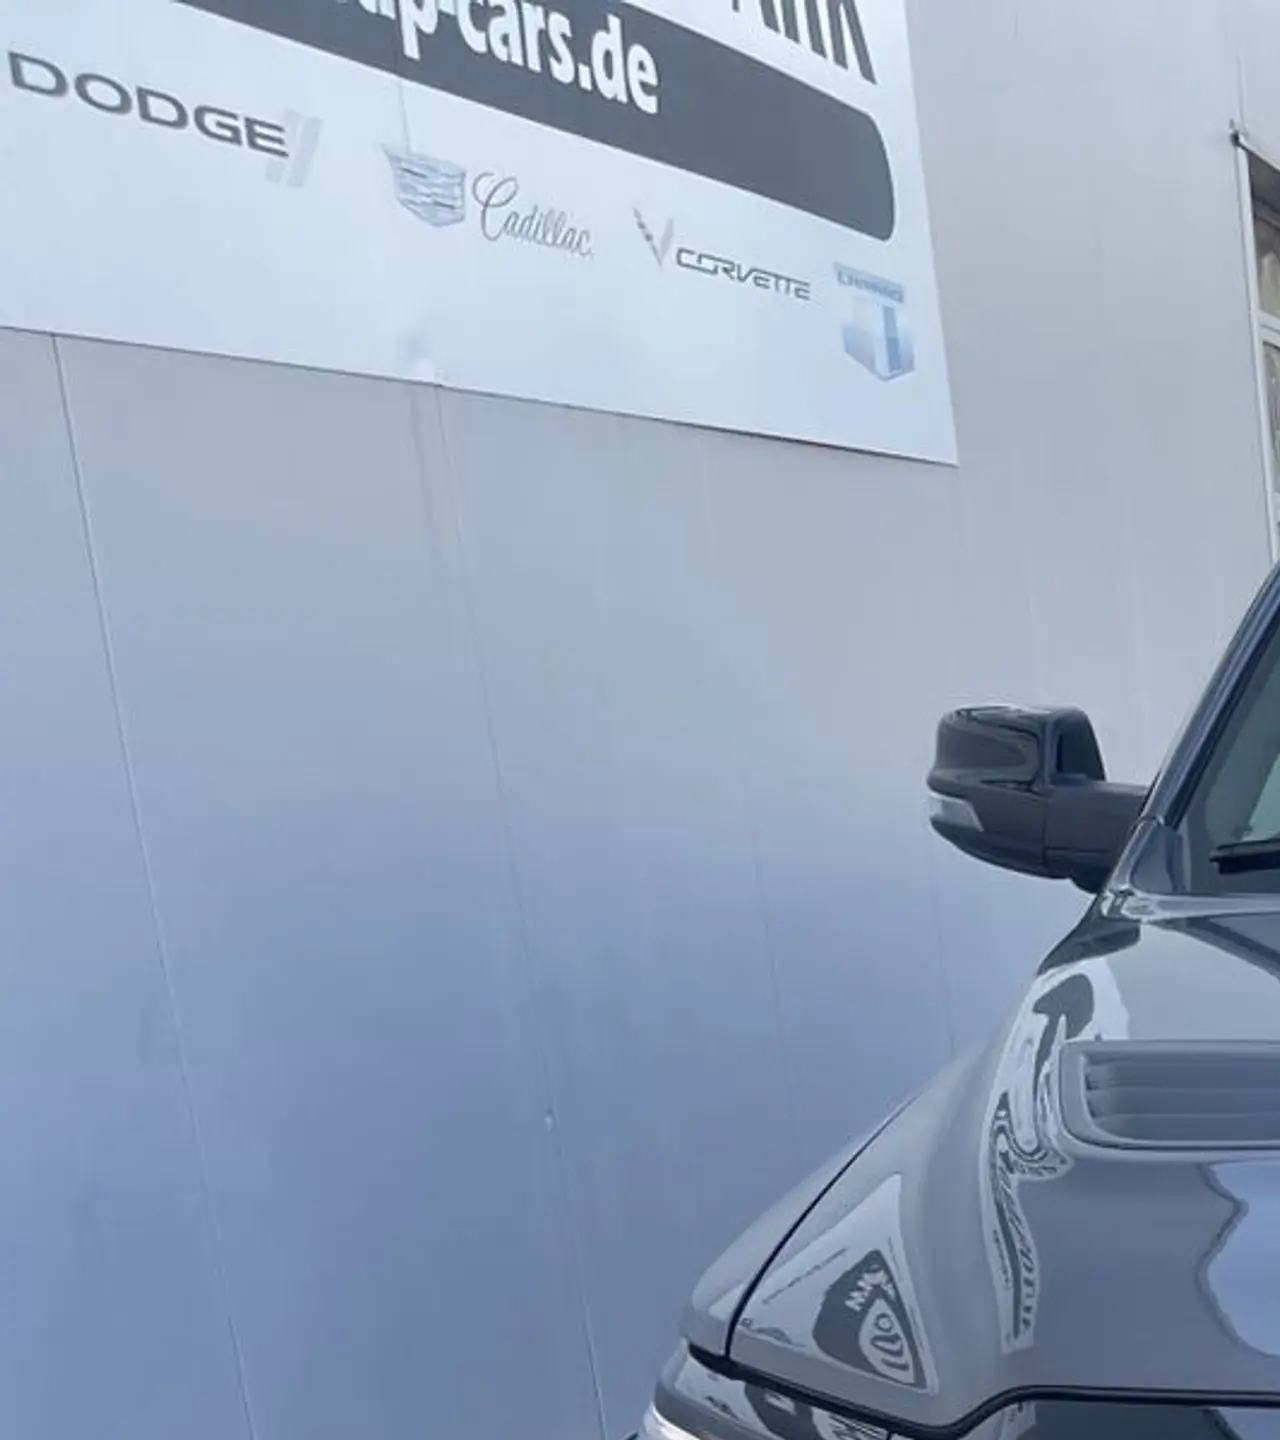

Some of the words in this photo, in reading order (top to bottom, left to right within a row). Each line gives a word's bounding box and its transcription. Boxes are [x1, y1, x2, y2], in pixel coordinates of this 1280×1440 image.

[8, 50, 290, 158] DODGE
[472, 172, 592, 257] Cadillac
[675, 247, 811, 301] CORVETTE
